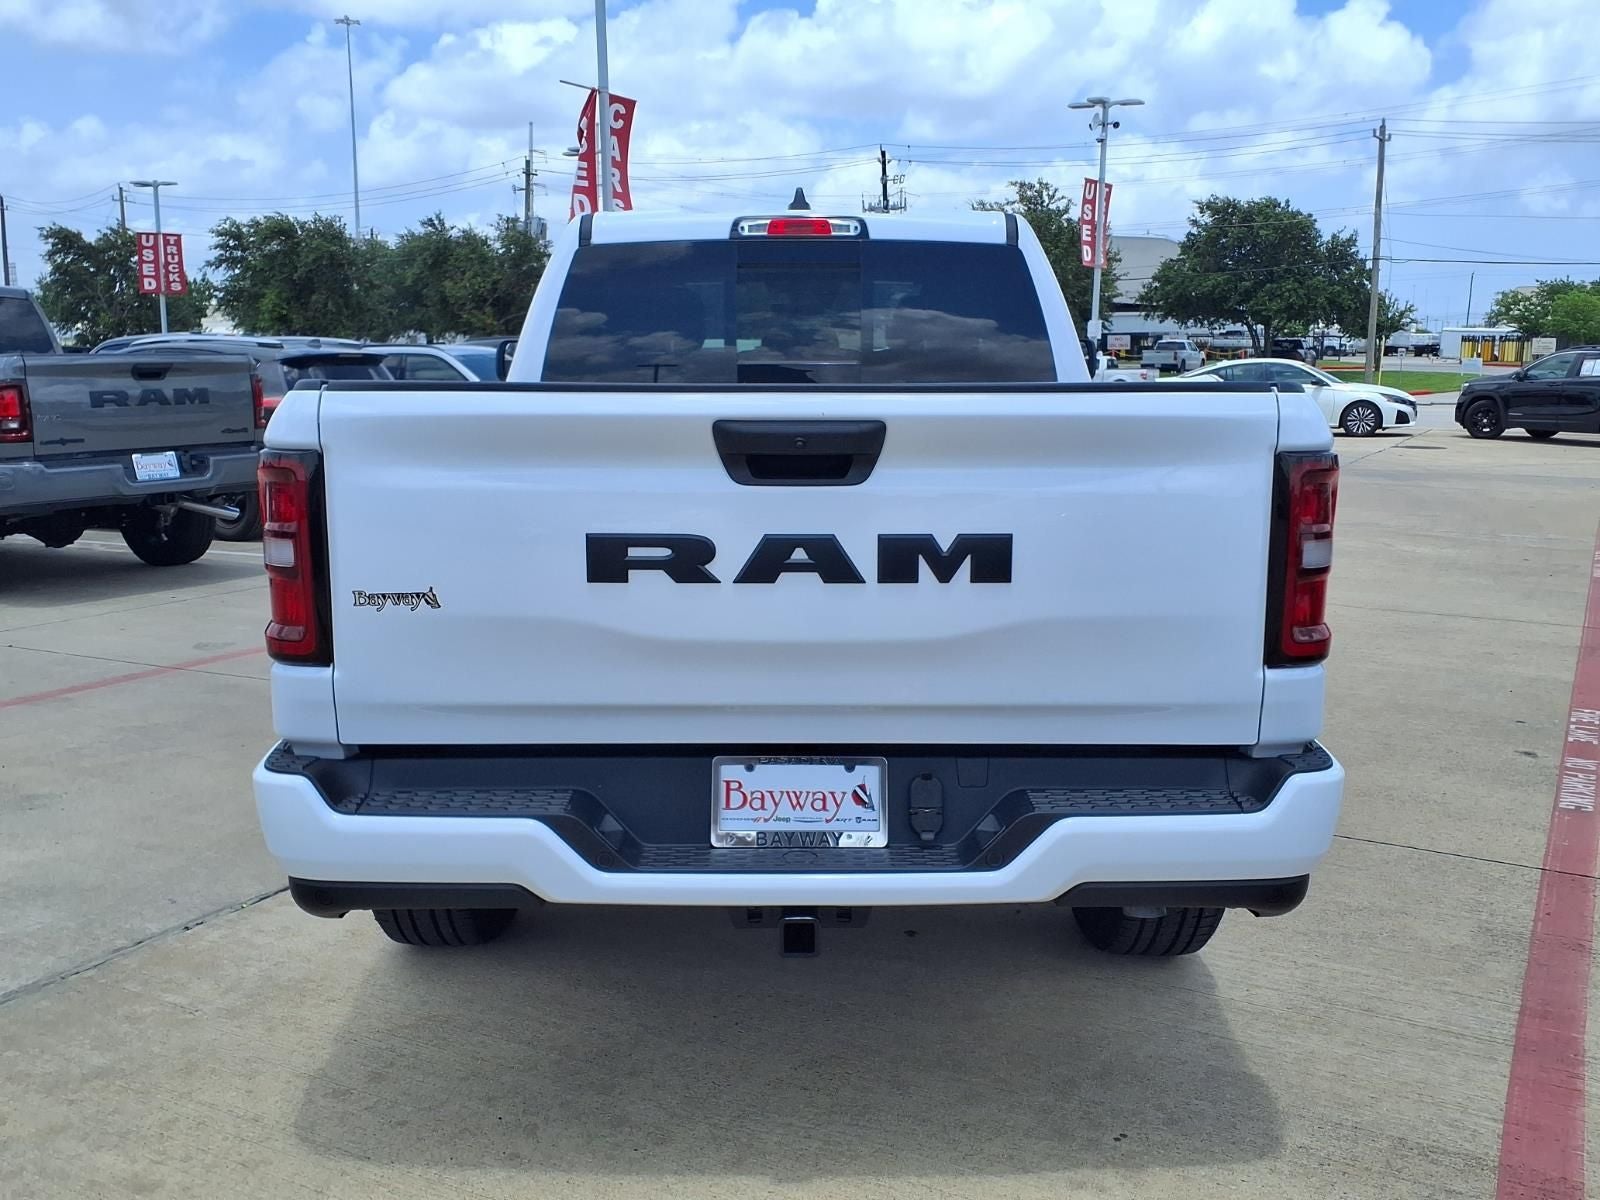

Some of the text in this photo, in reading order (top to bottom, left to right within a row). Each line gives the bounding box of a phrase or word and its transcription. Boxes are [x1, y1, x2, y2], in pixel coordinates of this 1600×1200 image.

[1082, 182, 1095, 262] USED
[141, 234, 157, 290] USED
[166, 236, 182, 291] TRUCKS
[89, 388, 210, 408] RAM
[586, 533, 1013, 584] RAM
[352, 590, 425, 612] Bayway
[1563, 757, 1600, 770] NO
[721, 779, 848, 824] Bayway
[1559, 771, 1597, 812] PARKING
[756, 832, 844, 847] BAYWAY
[772, 815, 791, 823] Jeep
